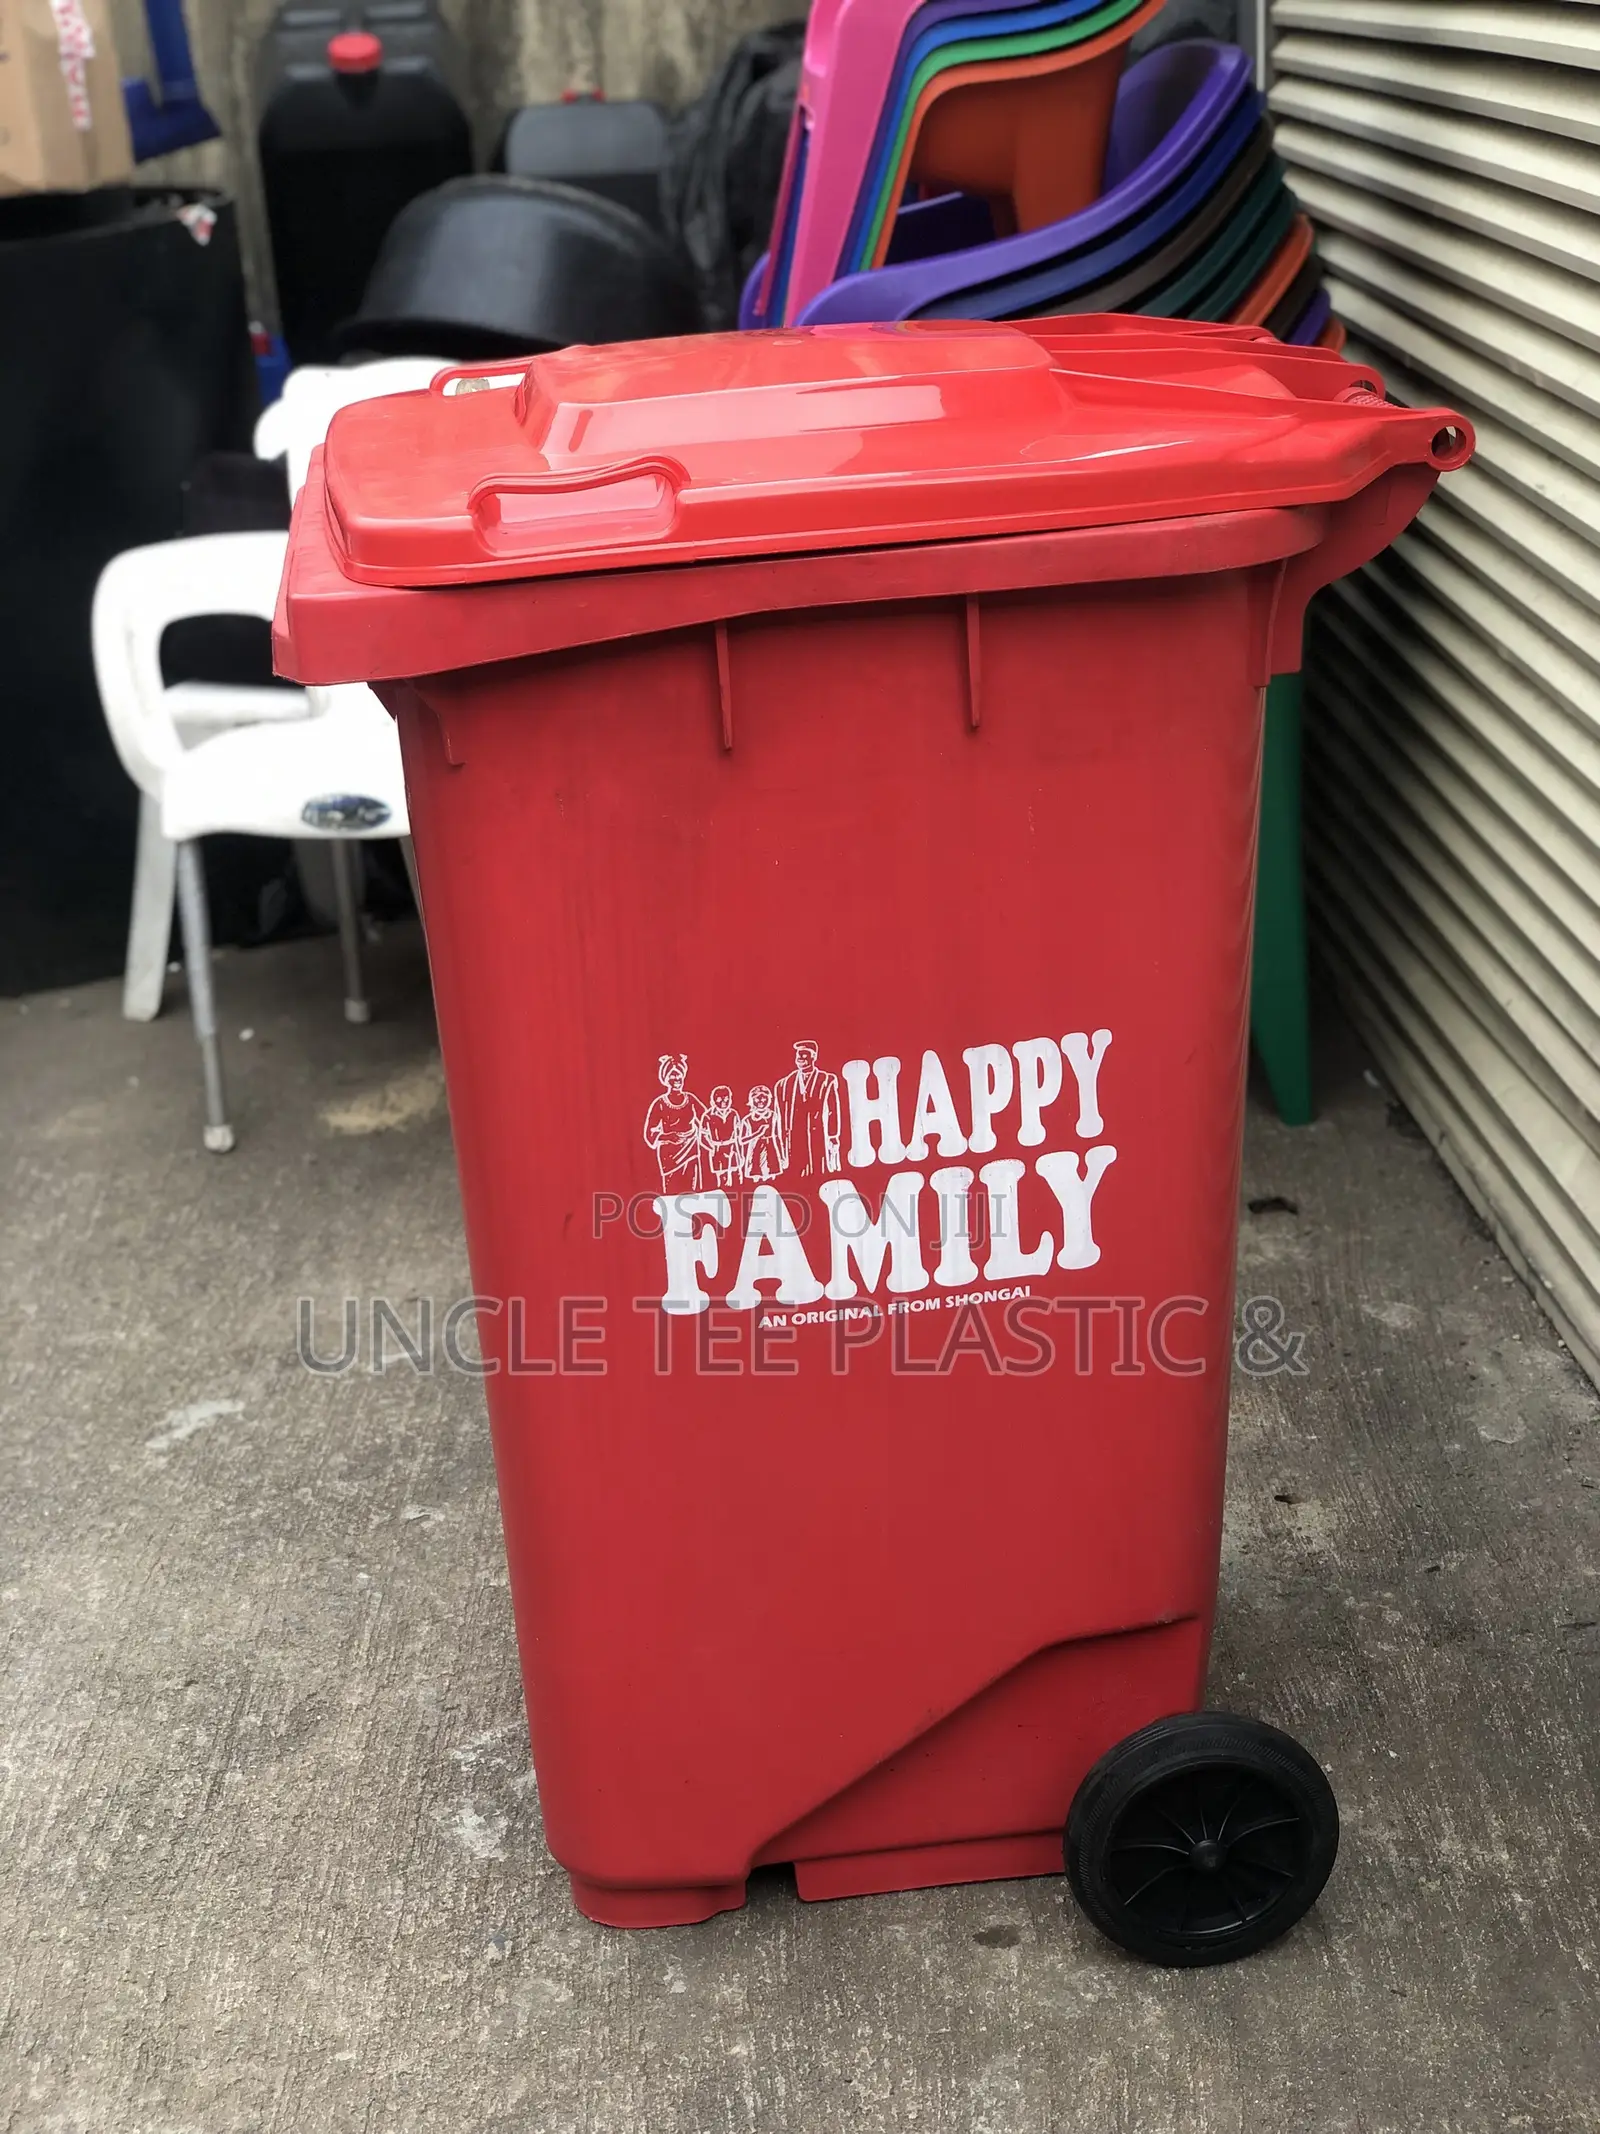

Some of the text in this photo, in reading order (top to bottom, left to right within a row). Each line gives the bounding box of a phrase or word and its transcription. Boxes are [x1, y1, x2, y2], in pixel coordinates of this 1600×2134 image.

[841, 1028, 1113, 1167] HAPPY
[652, 1145, 1117, 1315] FAMILY
[758, 1285, 1031, 1328] AN ORIGINAL FROM SHONGAI
